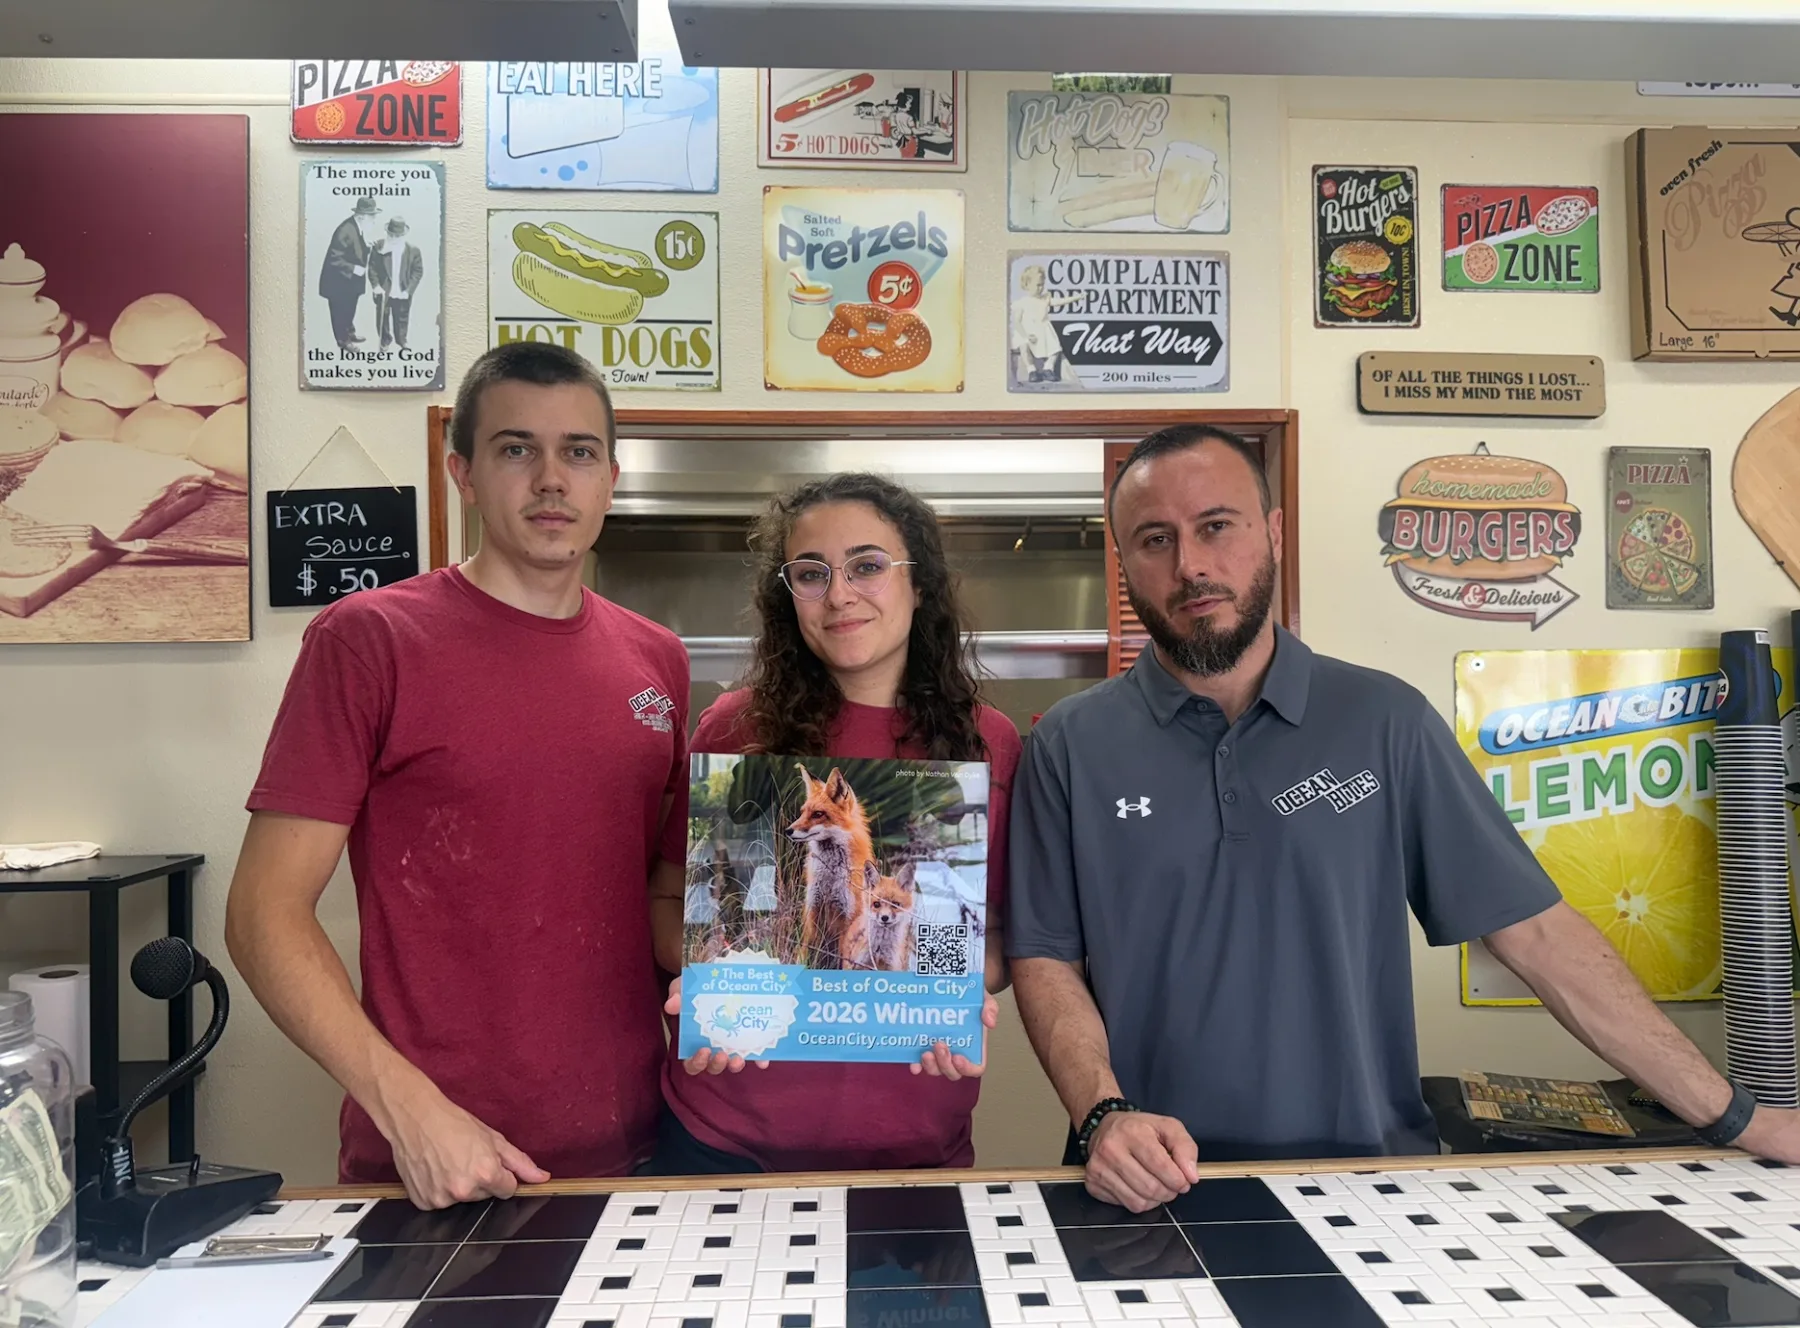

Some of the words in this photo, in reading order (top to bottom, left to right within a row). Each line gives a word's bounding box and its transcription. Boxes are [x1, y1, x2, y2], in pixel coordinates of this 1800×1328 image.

[298, 60, 398, 106] PIZZA
[568, 58, 663, 99] HERE
[355, 93, 447, 136] ZONE
[806, 134, 837, 154] HOT
[838, 136, 880, 155] DOGS
[313, 165, 348, 179] The
[353, 168, 396, 179] more
[400, 169, 431, 184] you
[1659, 169, 1688, 196] oven
[1687, 139, 1723, 176] fresh
[332, 183, 411, 199] complain
[1338, 176, 1379, 208] Hot
[803, 214, 842, 225] Salted
[1321, 184, 1411, 237] Burgers
[1457, 194, 1533, 246] PIZZA
[778, 210, 949, 271] Pretzels
[810, 227, 835, 238] Soft
[1047, 258, 1222, 286] COMPLAINT
[1503, 243, 1583, 283] ZONE
[878, 274, 914, 304] 5¢
[1402, 279, 1411, 290] IN
[1047, 289, 1222, 315] DEPARTMENT
[1402, 292, 1411, 316] BEST
[602, 326, 713, 368] DOGS
[1062, 322, 1136, 356] That
[1140, 325, 1211, 363] Way
[1659, 332, 1694, 352] Large
[308, 348, 334, 361] the
[339, 348, 394, 364] longer
[398, 348, 435, 362] God
[309, 365, 363, 379] makes
[367, 367, 398, 381] you
[403, 364, 434, 379] live
[611, 369, 650, 383] Town!
[1102, 372, 1129, 383] 200
[1132, 371, 1172, 383] miles
[1372, 370, 1393, 382] OF
[1397, 370, 1426, 383] ALL
[1431, 371, 1462, 384] THE
[1466, 372, 1523, 385] THINGS
[1528, 373, 1534, 385] I
[1538, 373, 1590, 386] LOST...
[1384, 386, 1390, 398] I
[1394, 386, 1431, 399] MISS
[1436, 387, 1458, 399] MY
[1462, 387, 1501, 400] MIND
[1505, 388, 1536, 401] THE
[1540, 389, 1584, 401] MOST
[1410, 470, 1553, 500] homemade
[1627, 463, 1692, 485] PIZZA
[275, 501, 367, 528] EXTRA
[1392, 509, 1575, 562] BURGERS
[1412, 577, 1464, 600] Fresh
[1463, 584, 1483, 607] &
[1483, 587, 1564, 606] Delicious
[1493, 696, 1625, 749] OCEAN
[895, 769, 915, 778] photo
[916, 769, 924, 778] by
[925, 770, 949, 778] Nathan
[1272, 768, 1340, 815] OCEAN
[1326, 770, 1380, 813] BITES
[702, 979, 715, 991] of
[718, 980, 758, 992] Ocean
[722, 967, 744, 980] The
[747, 968, 774, 980] Best
[812, 977, 848, 993] Best
[852, 977, 871, 993] of
[874, 978, 929, 994] Ocean
[741, 1016, 770, 1031] City
[807, 1001, 868, 1024] 2026
[874, 1001, 970, 1026] Winner
[798, 1031, 974, 1050] OceanCity.com/Best-of
